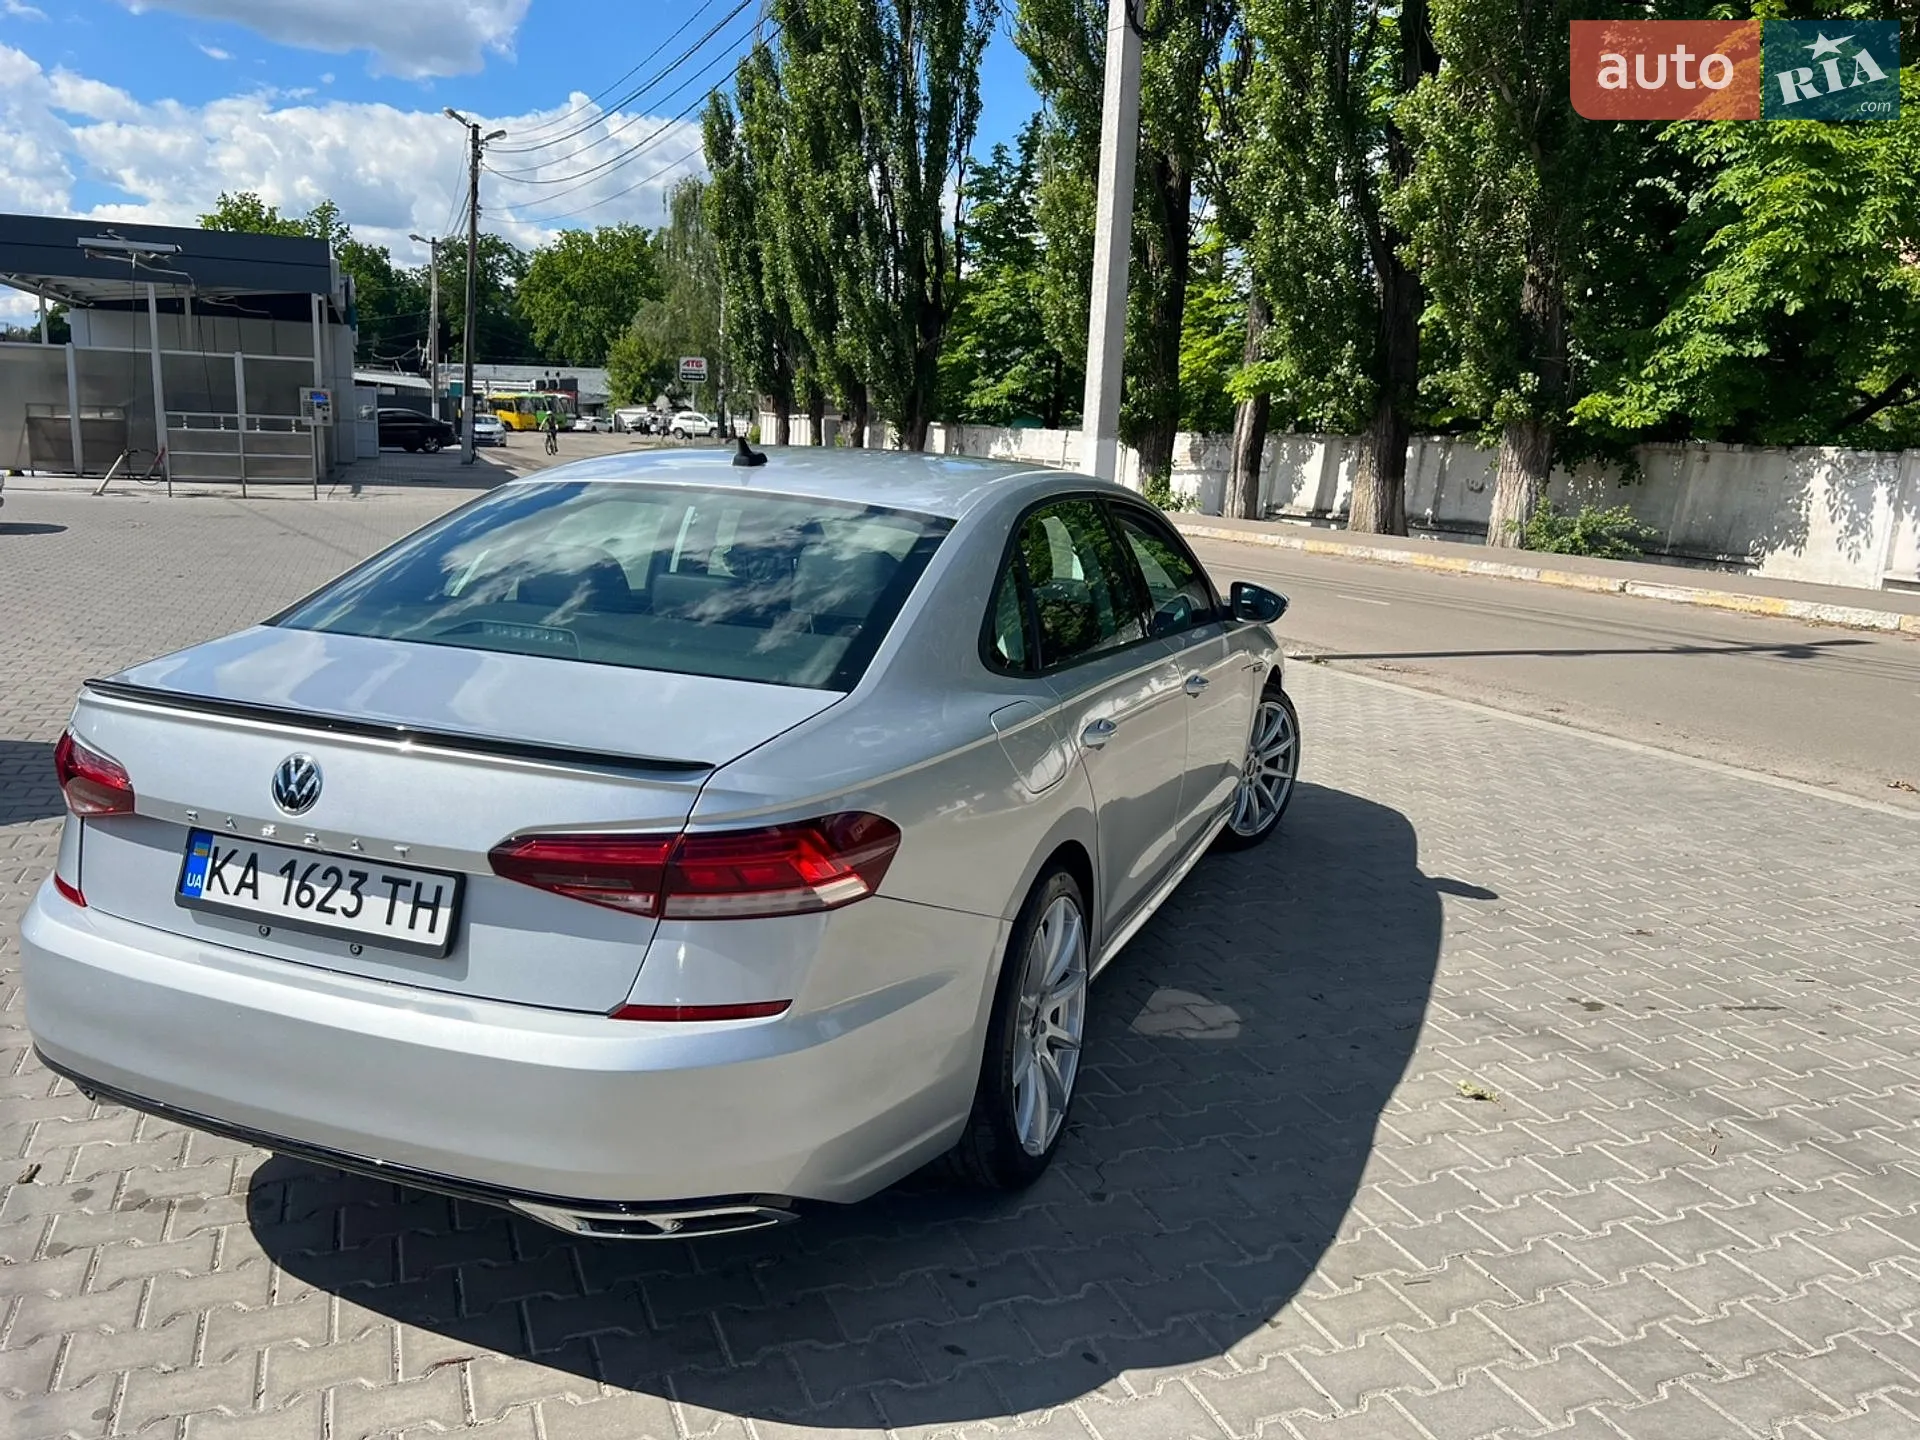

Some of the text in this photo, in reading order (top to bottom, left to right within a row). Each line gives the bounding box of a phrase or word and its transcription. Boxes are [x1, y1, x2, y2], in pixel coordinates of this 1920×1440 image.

[187, 872, 202, 889] UA
[206, 846, 443, 934] KA 1623 TH
